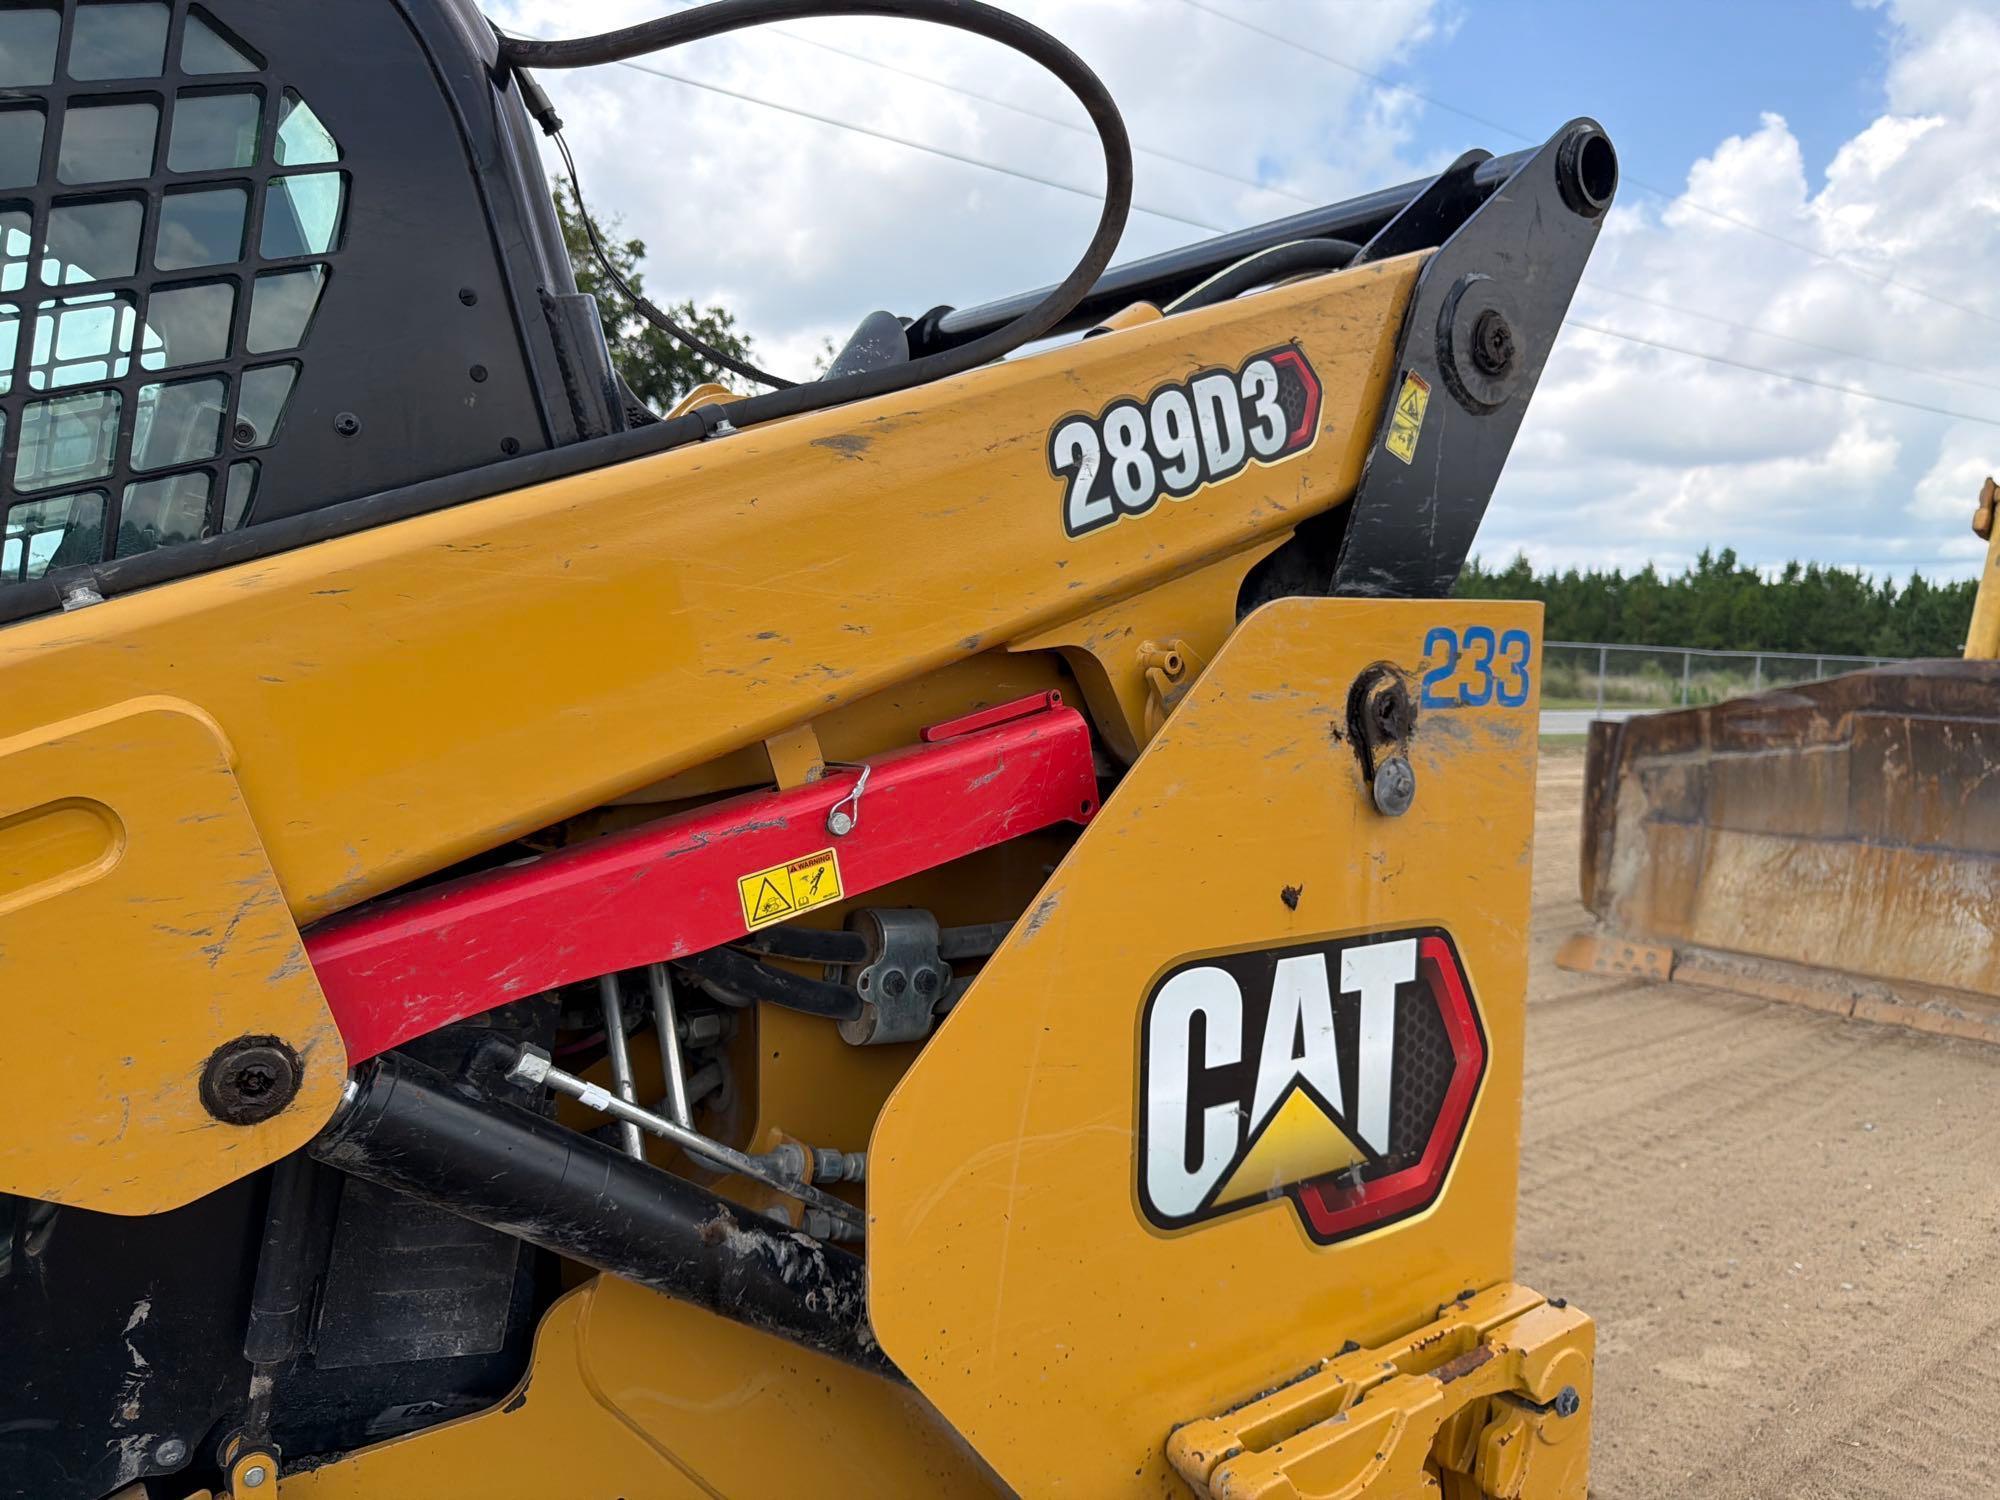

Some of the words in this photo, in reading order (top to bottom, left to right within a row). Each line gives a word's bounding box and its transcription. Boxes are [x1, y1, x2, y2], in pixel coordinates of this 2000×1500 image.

[1054, 360, 1287, 529] 289D3
[1421, 626, 1531, 708] 233
[798, 854, 831, 870] WARNING
[1147, 938, 1417, 1218] CAT
